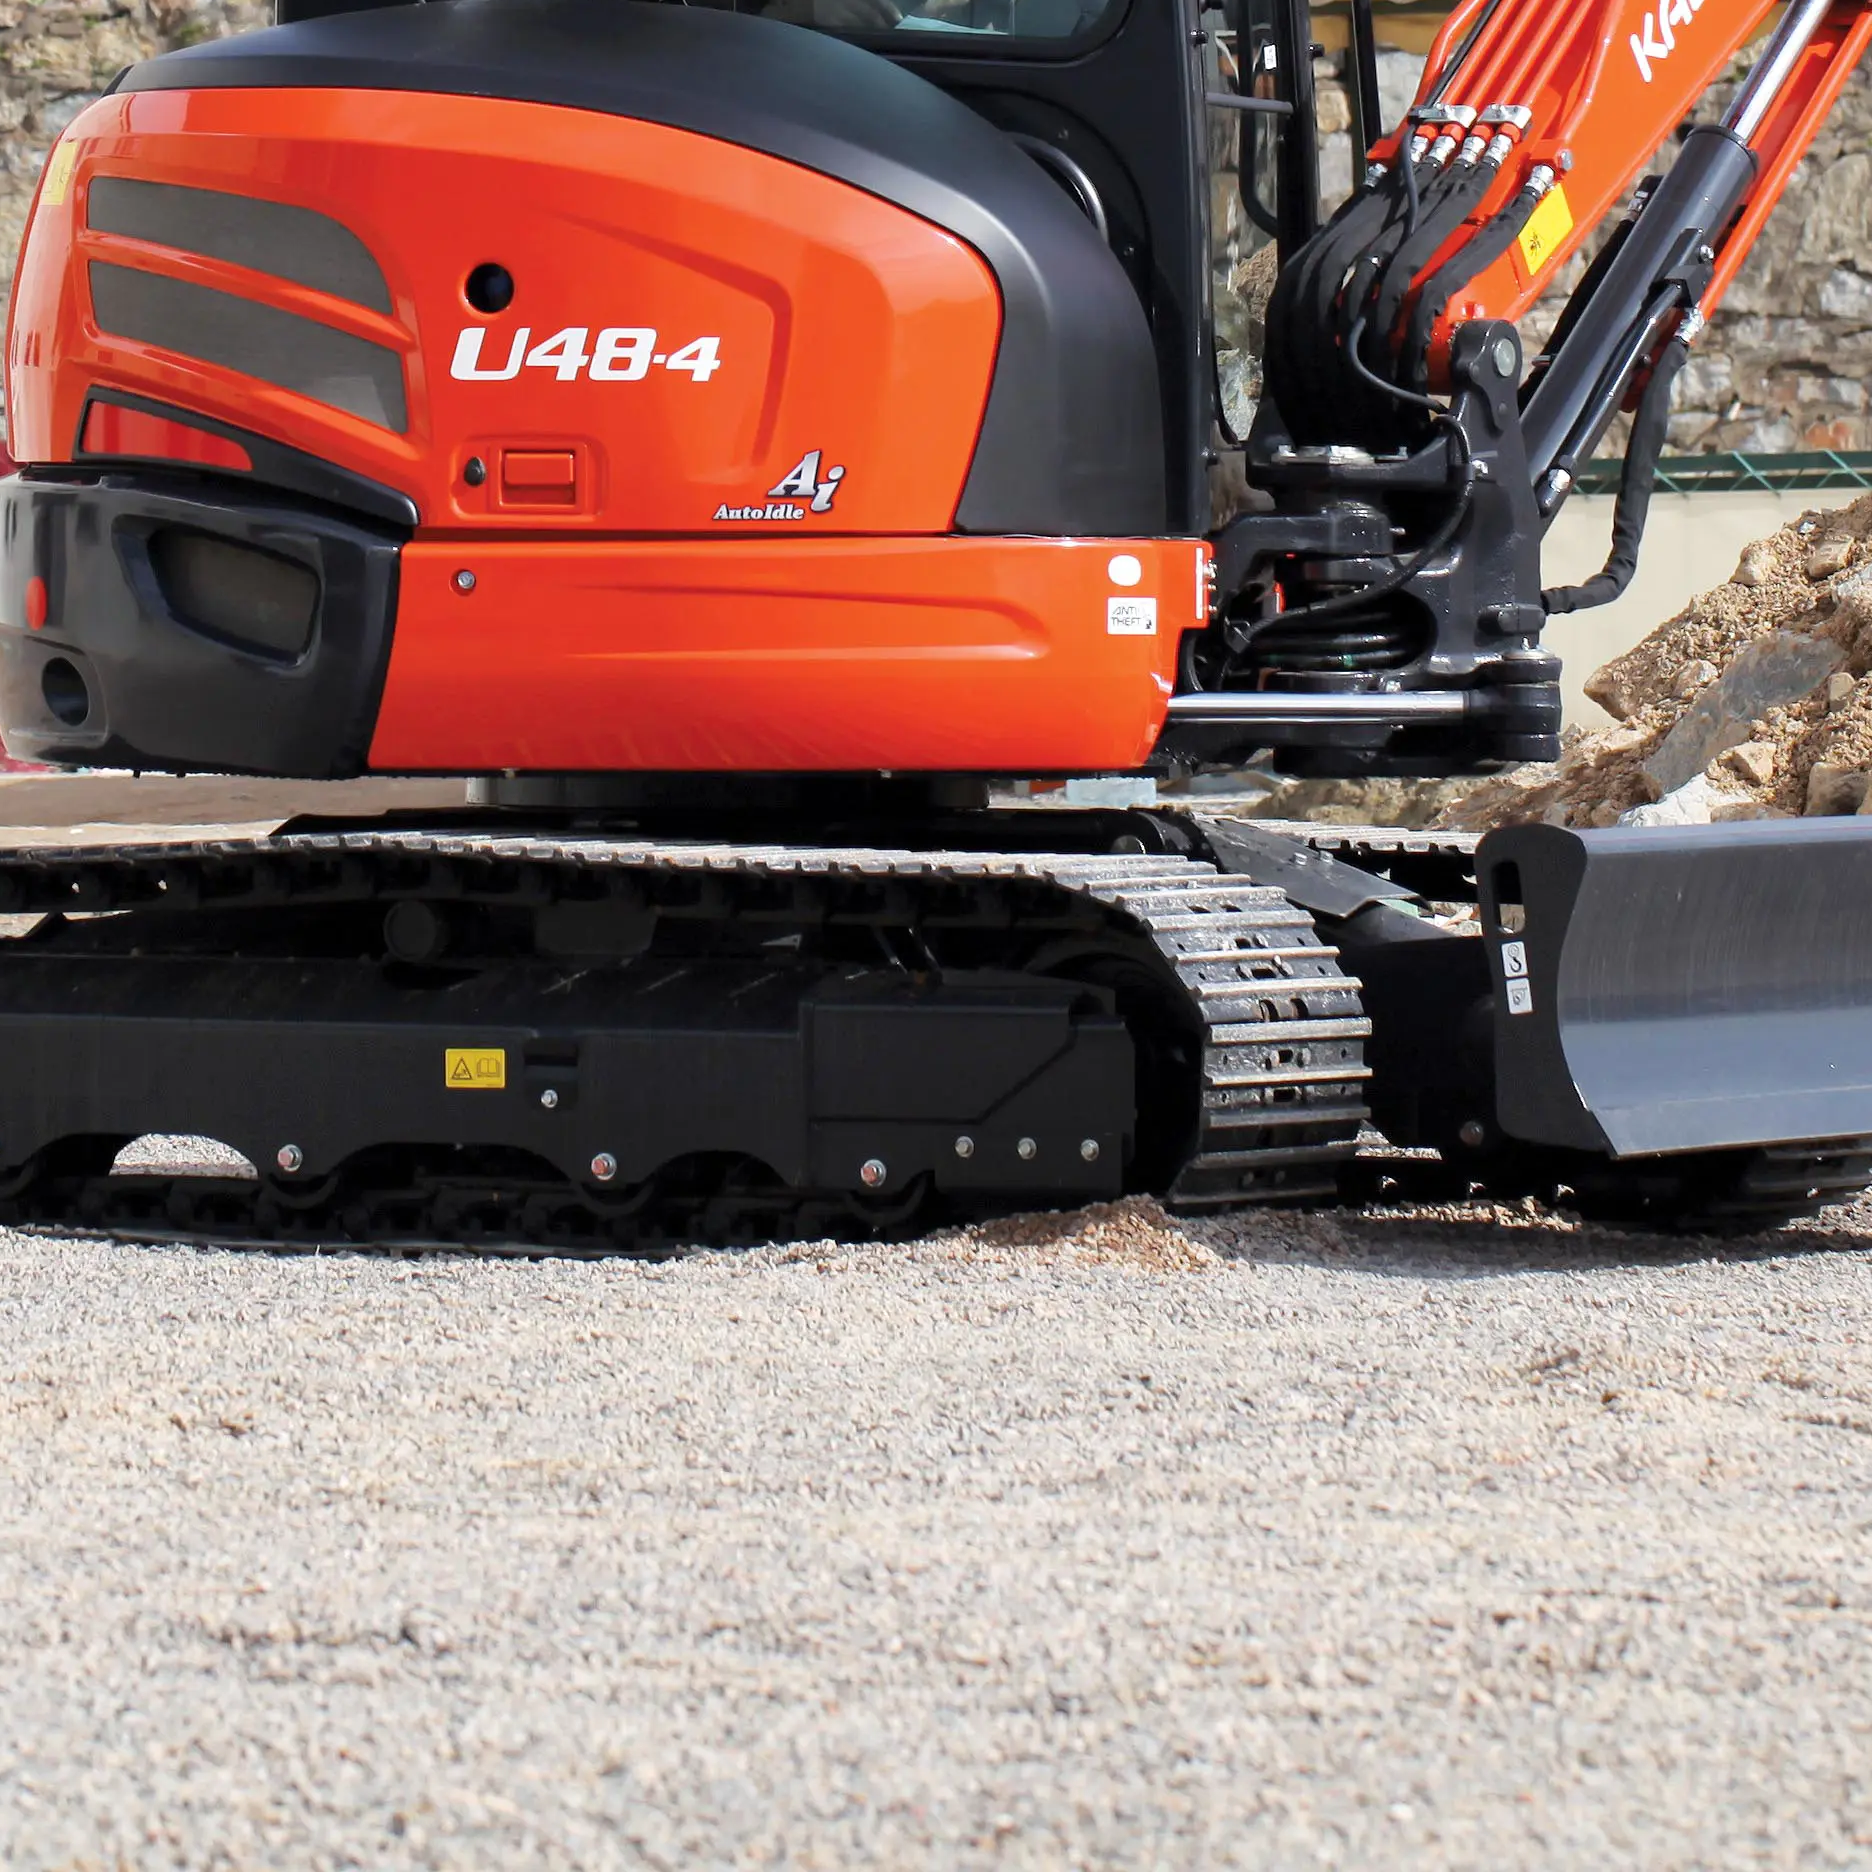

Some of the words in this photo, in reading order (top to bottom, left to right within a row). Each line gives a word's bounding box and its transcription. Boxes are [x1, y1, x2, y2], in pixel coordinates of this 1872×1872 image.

[449, 327, 721, 382] U48-4
[766, 449, 845, 513] Ai
[712, 503, 805, 521] AutoIdle
[1111, 616, 1142, 627] THEFT
